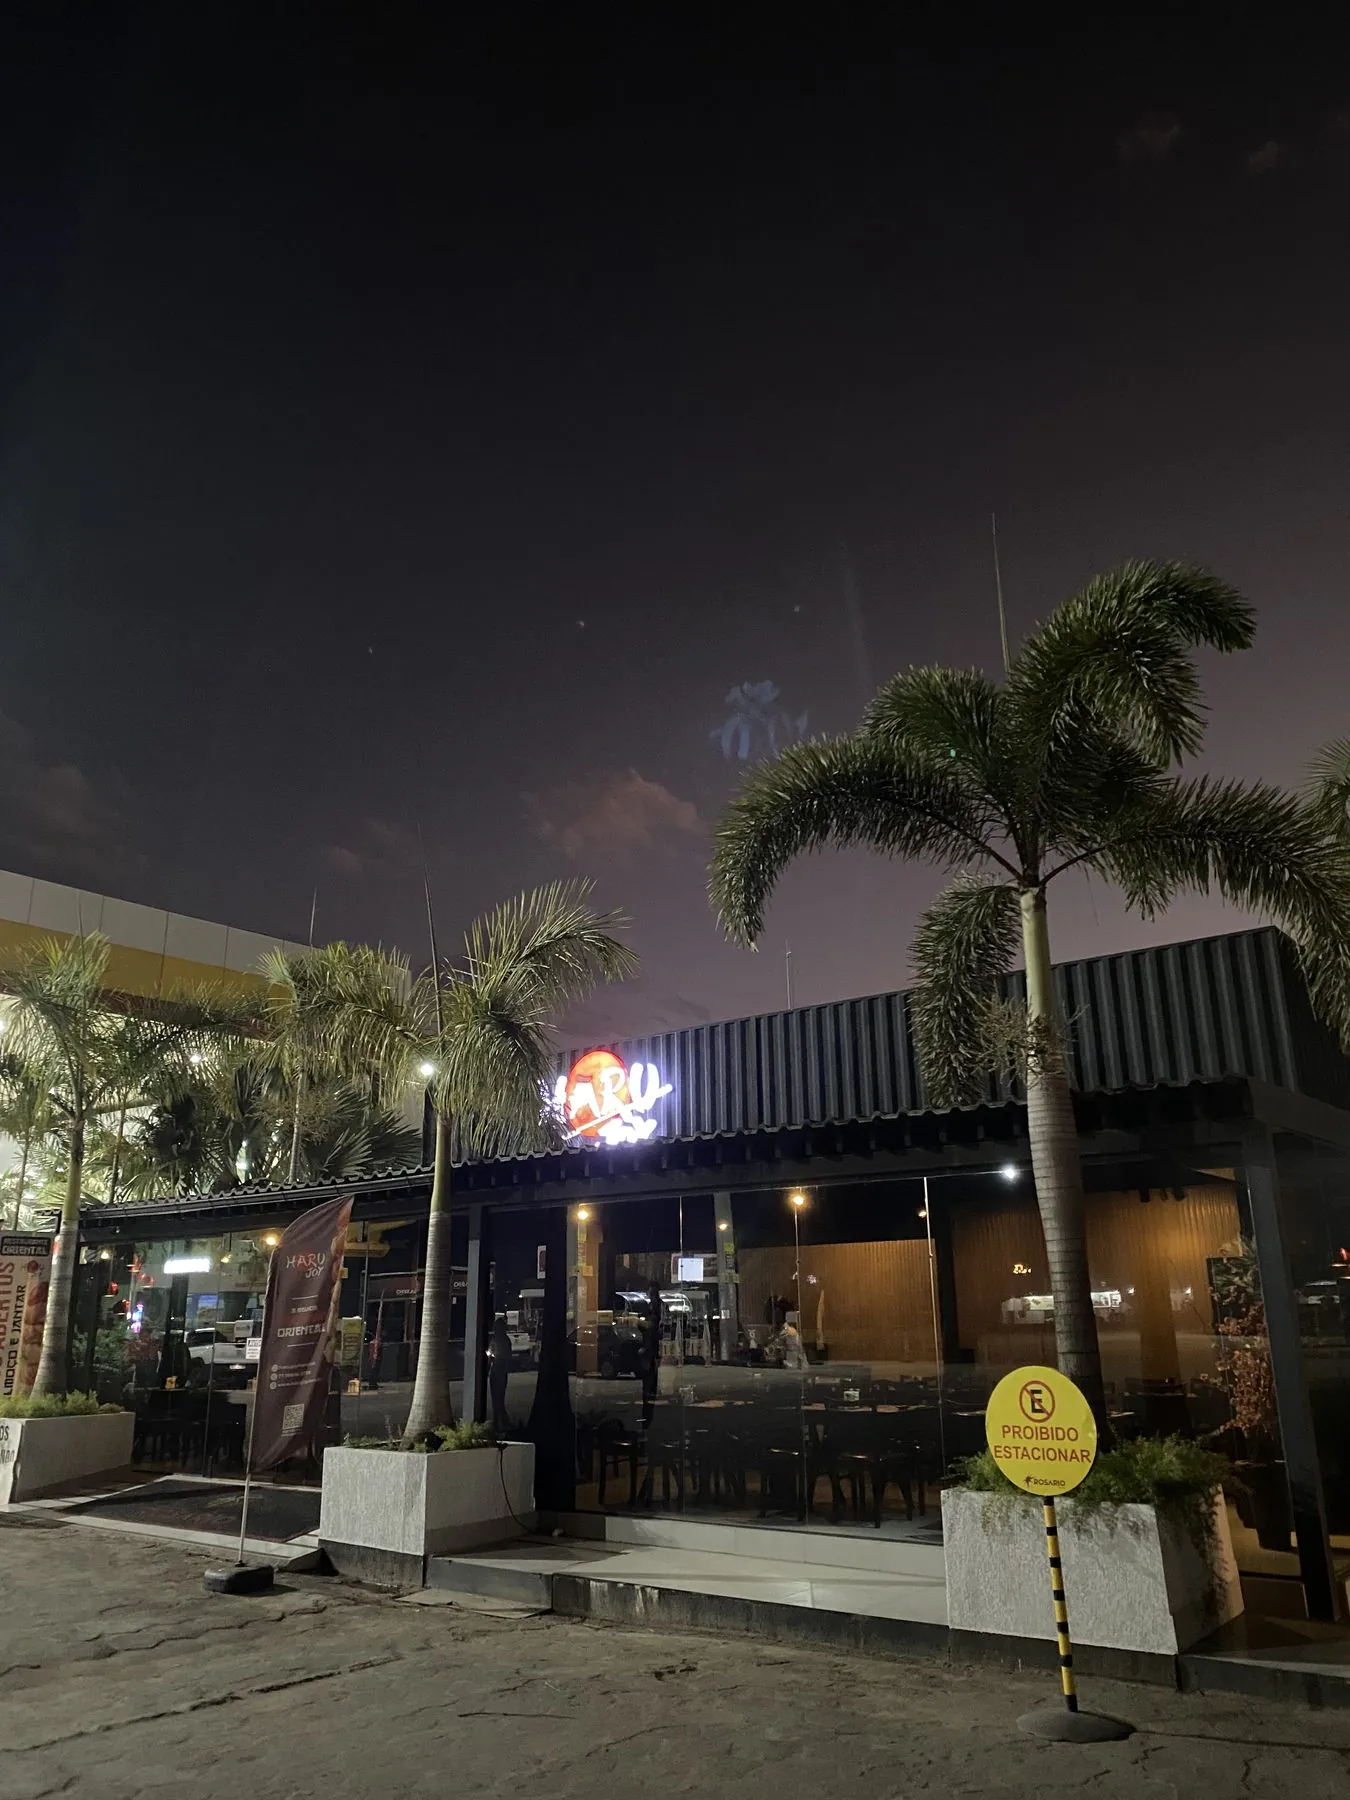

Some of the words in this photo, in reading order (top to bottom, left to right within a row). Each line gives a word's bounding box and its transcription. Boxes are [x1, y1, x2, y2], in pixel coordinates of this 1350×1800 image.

[2, 1245, 48, 1255] ORIENTAL
[286, 1253, 326, 1269] HARU
[305, 1266, 324, 1279] JOY
[12, 1285, 27, 1334] JANTAR
[277, 1323, 327, 1339] ORIENTAL
[10, 1338, 20, 1346] E
[3, 1350, 18, 1397] LMOÇO
[1002, 1424, 1079, 1442] PROIBIDO
[994, 1445, 1092, 1464] ESTACIONAR
[1033, 1478, 1066, 1488] ROSARIO
